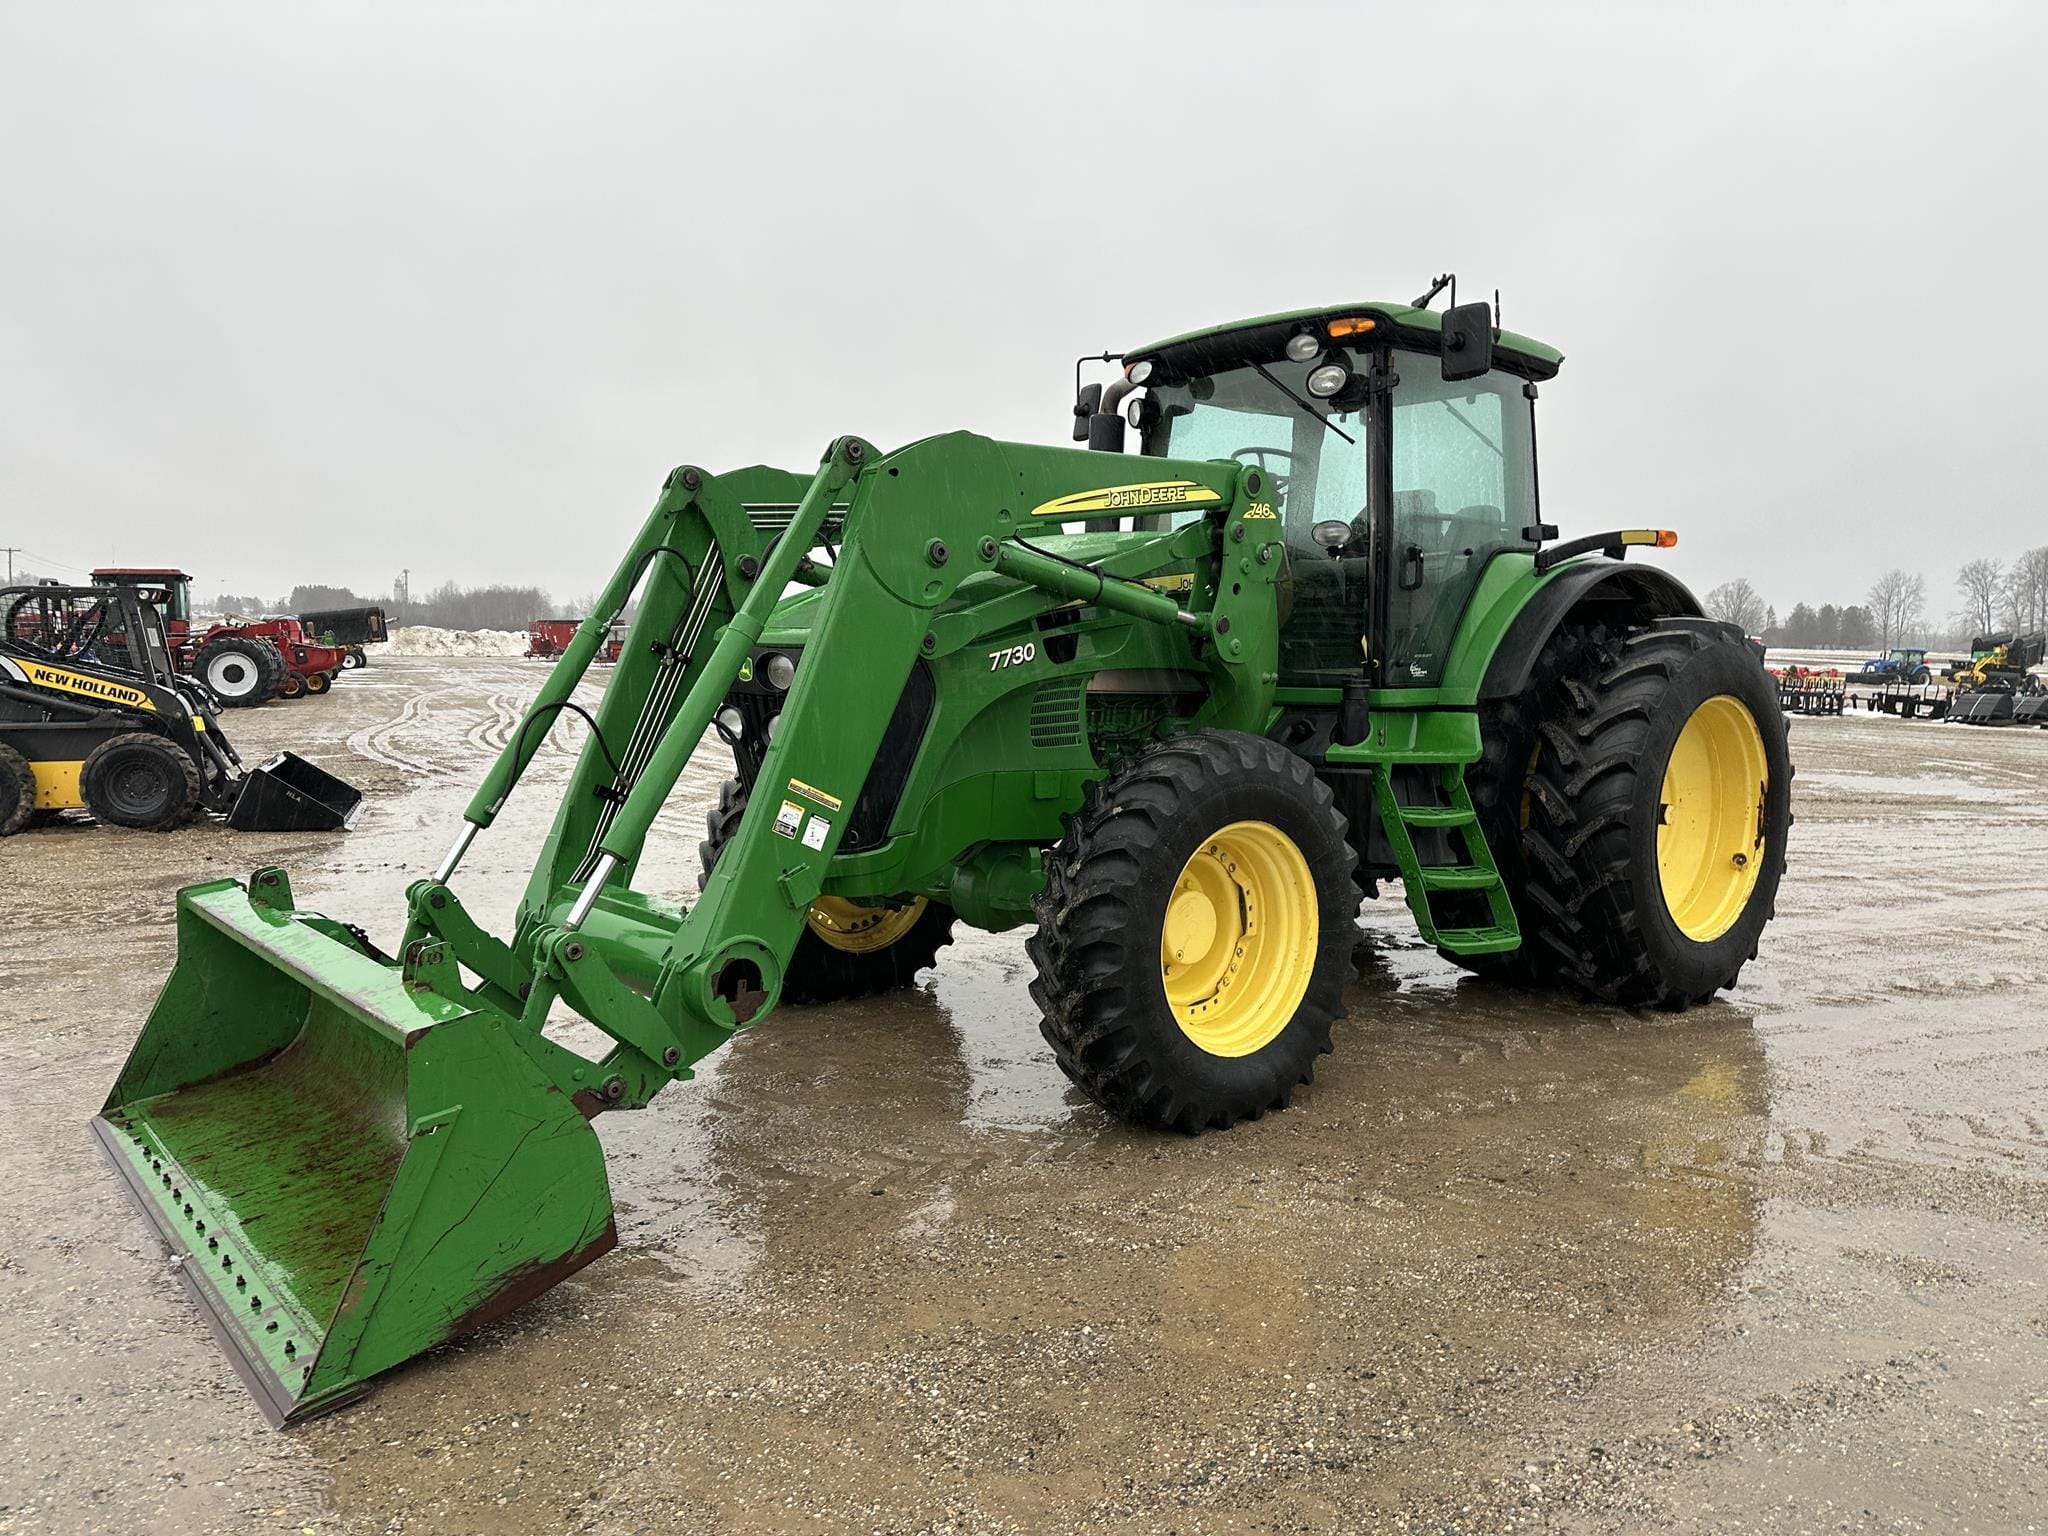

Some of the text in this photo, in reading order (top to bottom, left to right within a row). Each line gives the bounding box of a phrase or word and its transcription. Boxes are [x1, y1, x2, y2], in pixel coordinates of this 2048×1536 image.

[1104, 486, 1186, 507] JOHN DEERE
[1249, 503, 1271, 518] 746
[988, 643, 1037, 672] 7730
[34, 669, 139, 702] NEW HOLLAND
